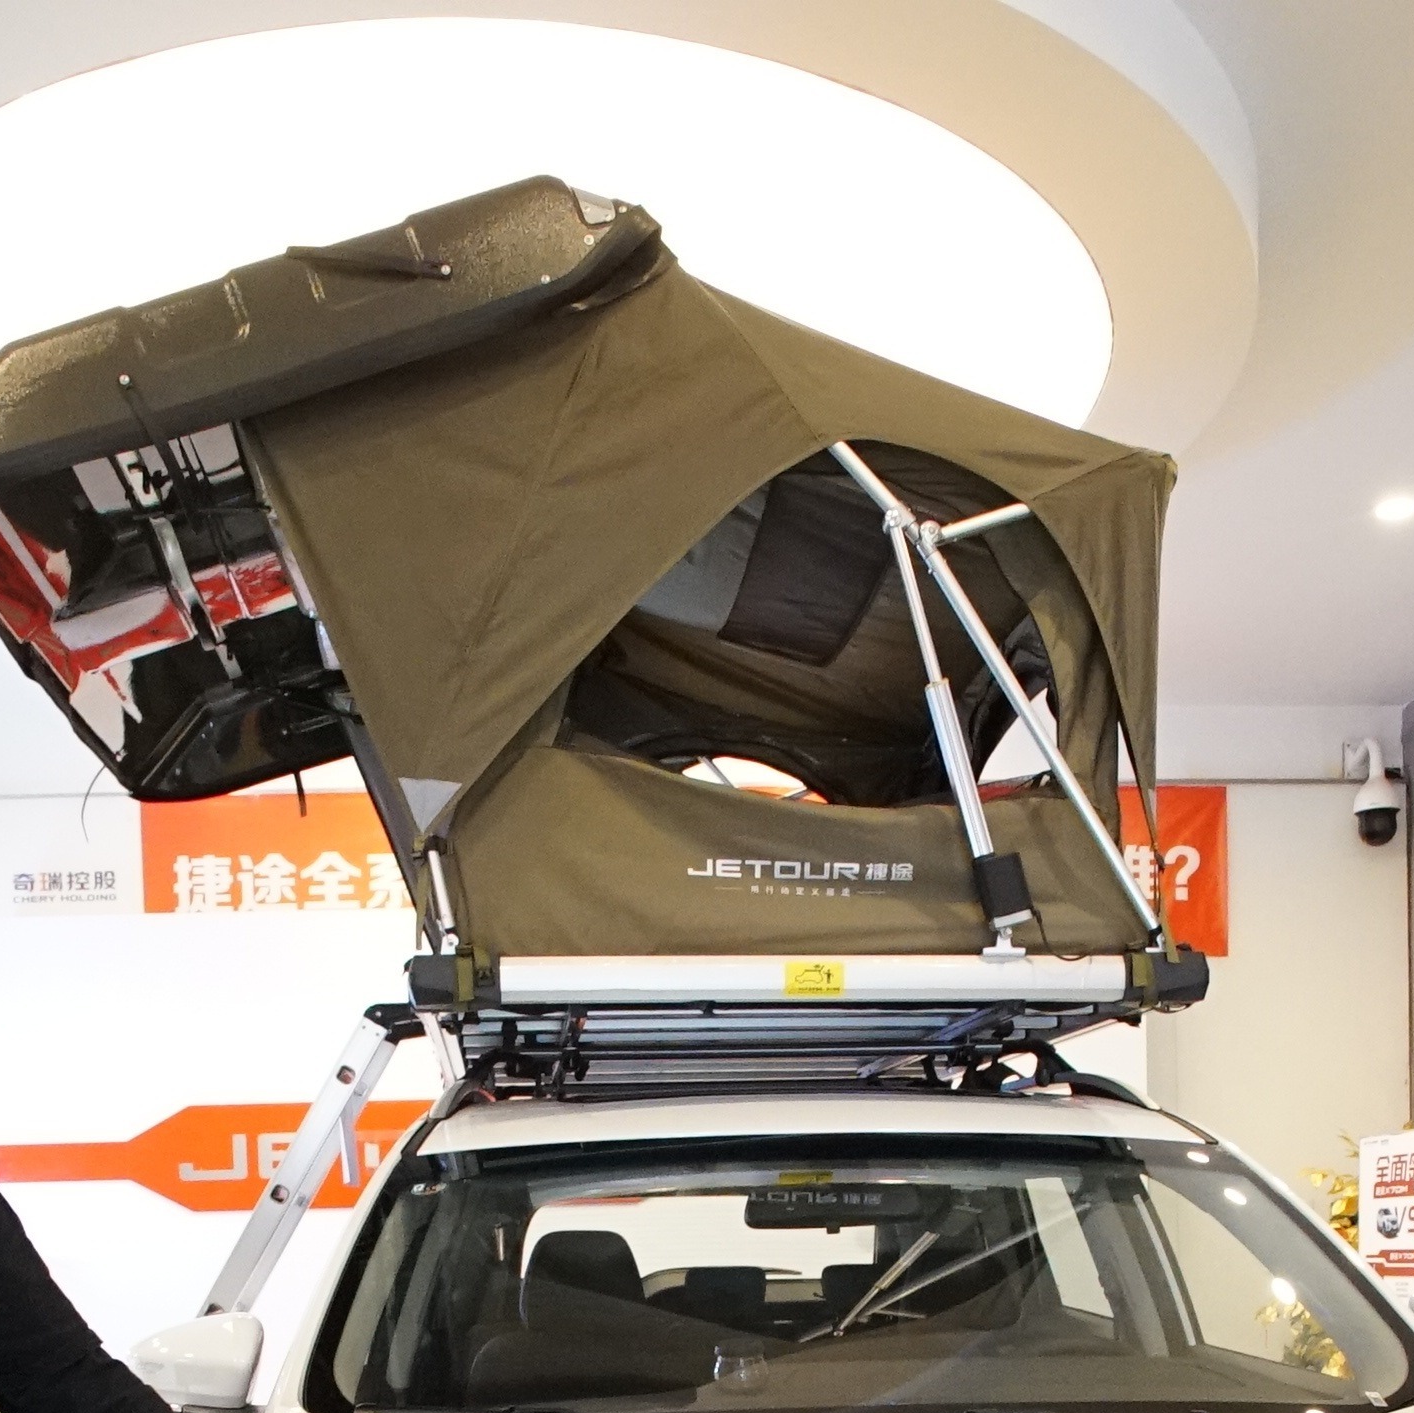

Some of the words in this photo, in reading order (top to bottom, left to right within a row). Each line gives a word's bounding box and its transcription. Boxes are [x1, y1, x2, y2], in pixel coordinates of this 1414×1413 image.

[687, 858, 860, 880] JETOUR
[865, 862, 914, 881] 捷途
[12, 870, 116, 892] 奇瑞控股
[59, 893, 118, 902] HOLDING
